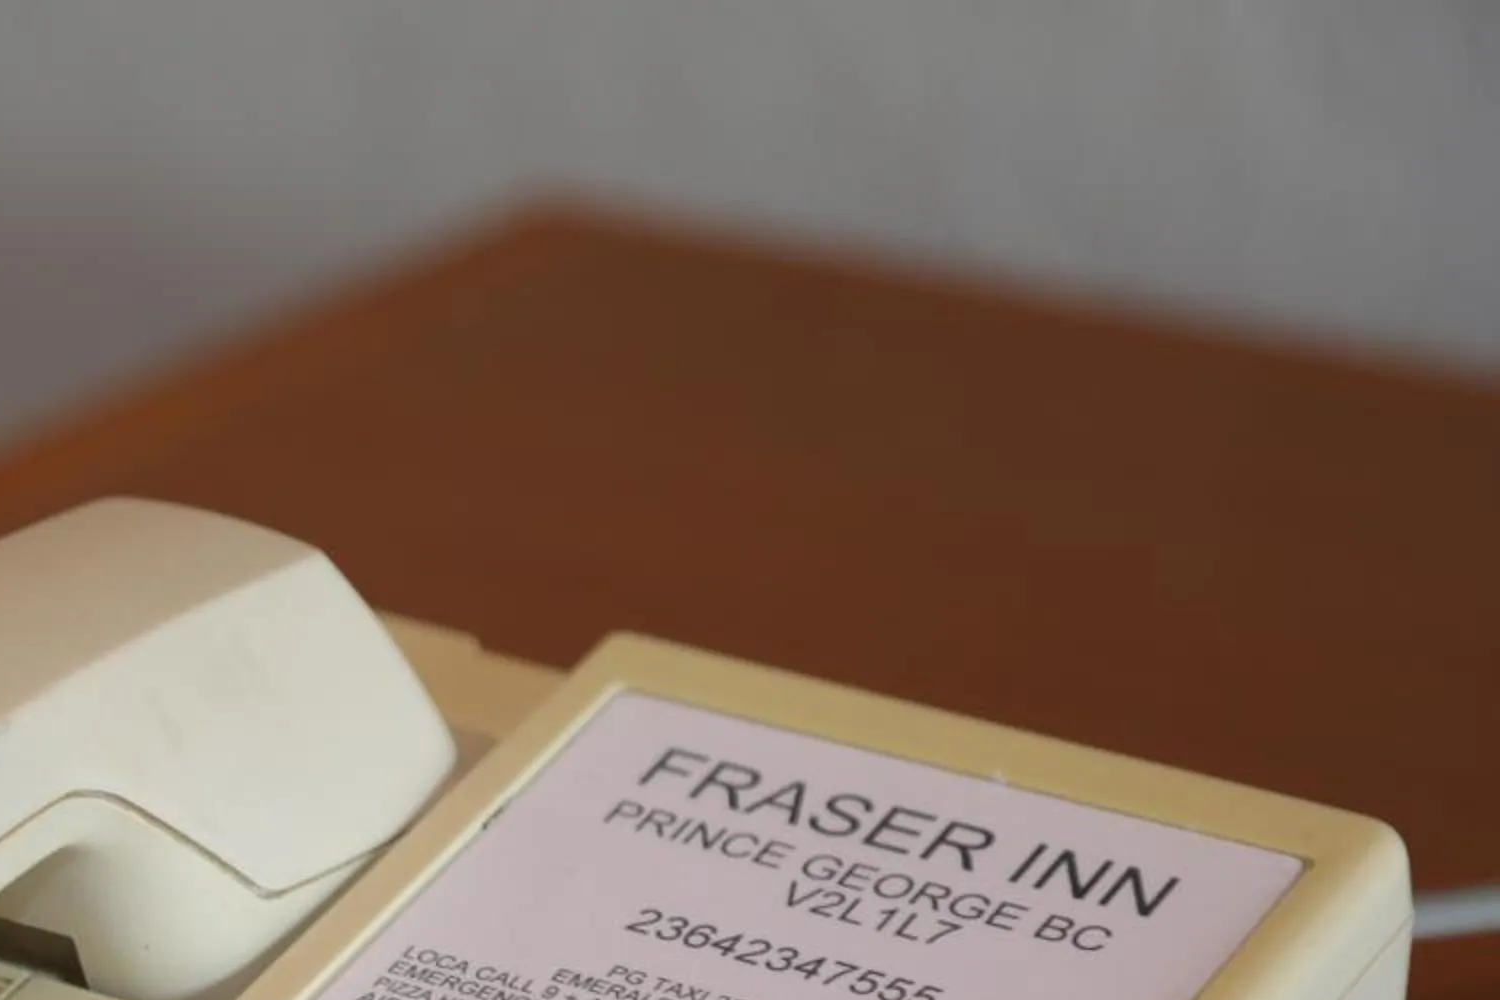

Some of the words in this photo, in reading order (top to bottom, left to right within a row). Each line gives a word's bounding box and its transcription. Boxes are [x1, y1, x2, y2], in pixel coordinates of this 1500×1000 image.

[638, 747, 996, 871] FRASER
[1008, 844, 1180, 917] INN
[604, 800, 796, 869] PRINCE
[801, 854, 1029, 931] GEORGE
[1034, 914, 1114, 953] BC
[783, 881, 963, 947] V2L1L7
[402, 946, 469, 974] LOCA
[475, 965, 534, 995] CALL
[541, 983, 560, 1000] 9
[607, 965, 647, 985] PG
